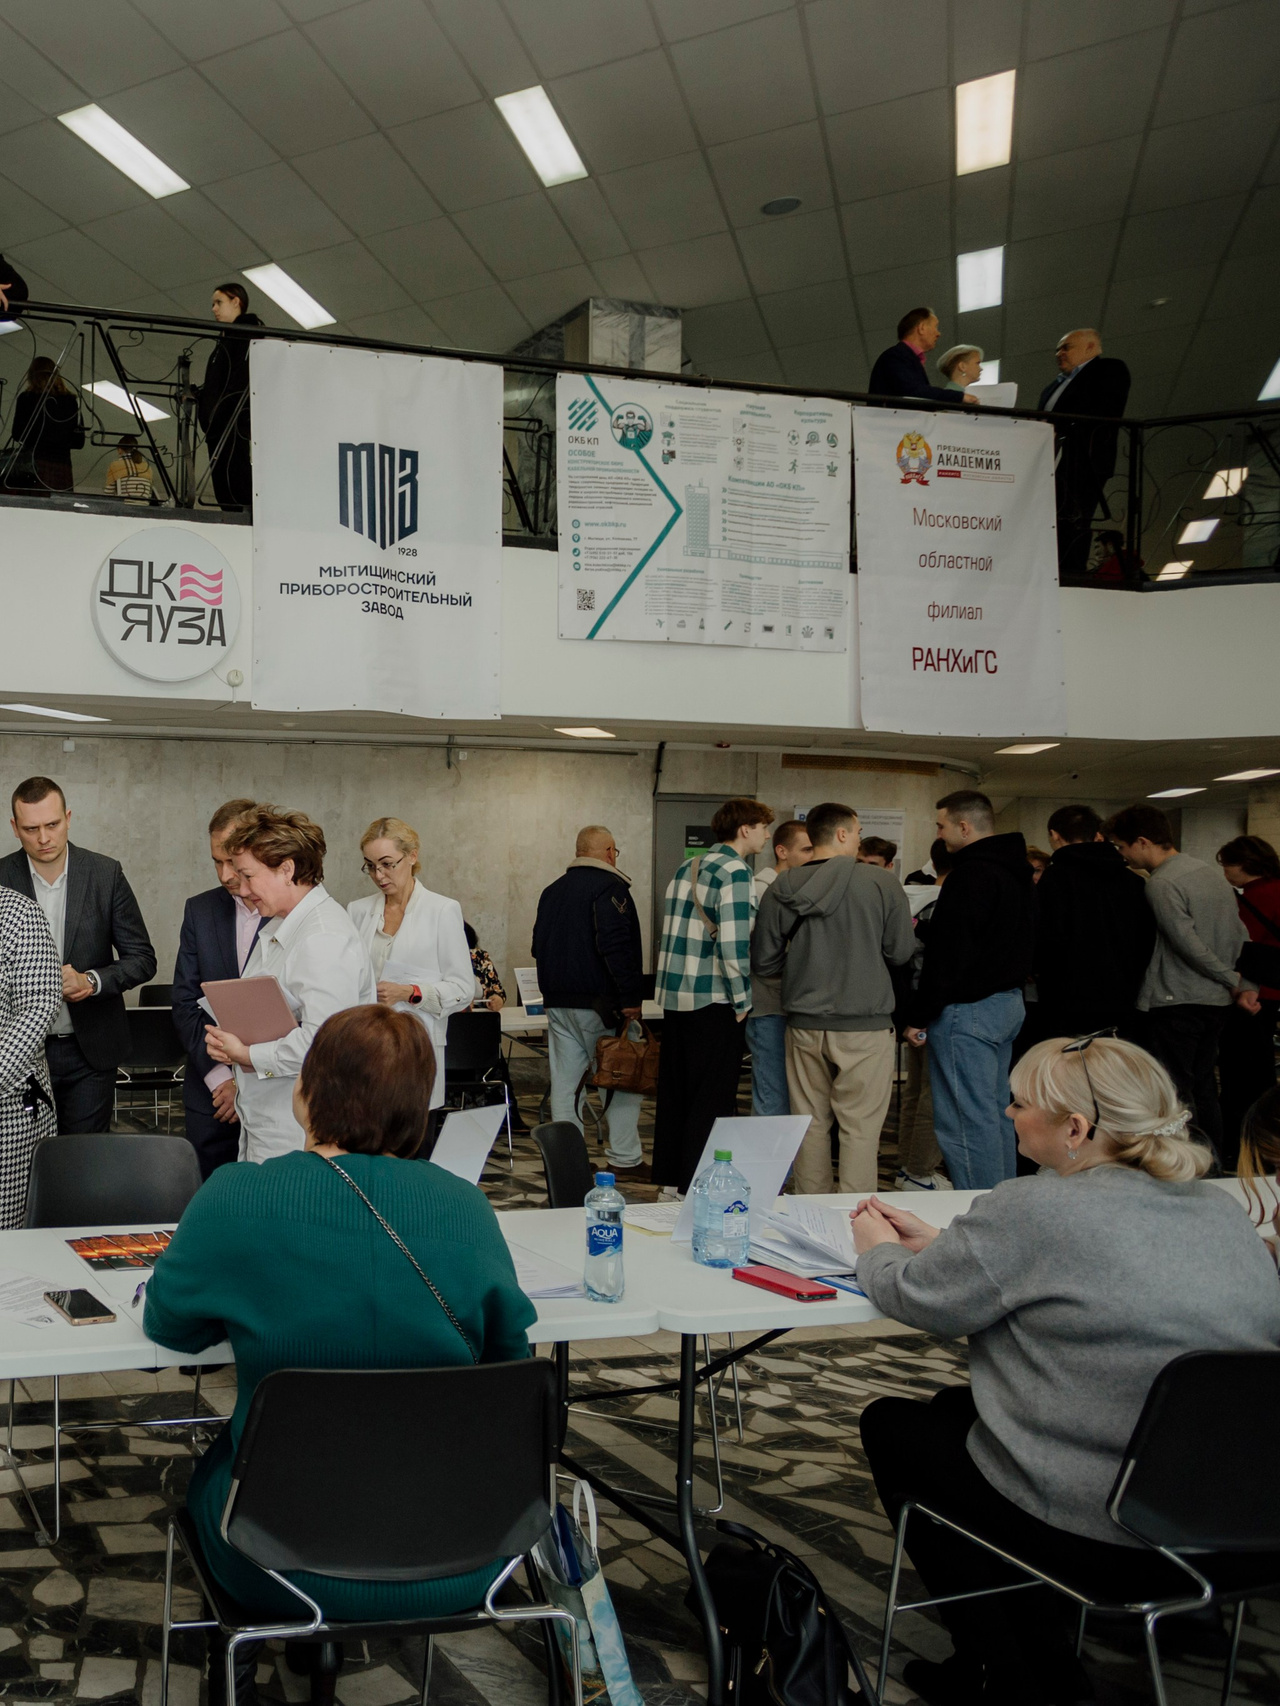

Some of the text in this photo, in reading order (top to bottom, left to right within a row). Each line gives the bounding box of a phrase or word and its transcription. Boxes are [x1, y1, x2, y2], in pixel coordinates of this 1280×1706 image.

[568, 436, 599, 446] ОКБ КП
[936, 444, 1000, 456] ПРЕЗИДЕНТСКАЯ
[936, 453, 1001, 471] АКАДЕМИЯ
[766, 480, 775, 488] АО
[338, 442, 419, 551] МПЗ
[913, 507, 1002, 532] Московский
[397, 546, 418, 558] 1928
[919, 551, 993, 572] областной
[99, 557, 178, 607] ДК
[319, 564, 437, 587] МЫТИЩИНСКИЙ
[279, 582, 473, 608] ПРИБОРОСТРОИТЕЛЬНЫЙ
[361, 600, 405, 621] ЗАВОД
[927, 601, 983, 622] филиал
[120, 602, 228, 647] ЯУЗА
[912, 647, 999, 674] РАНХиГС
[591, 1226, 619, 1240] AQUA
